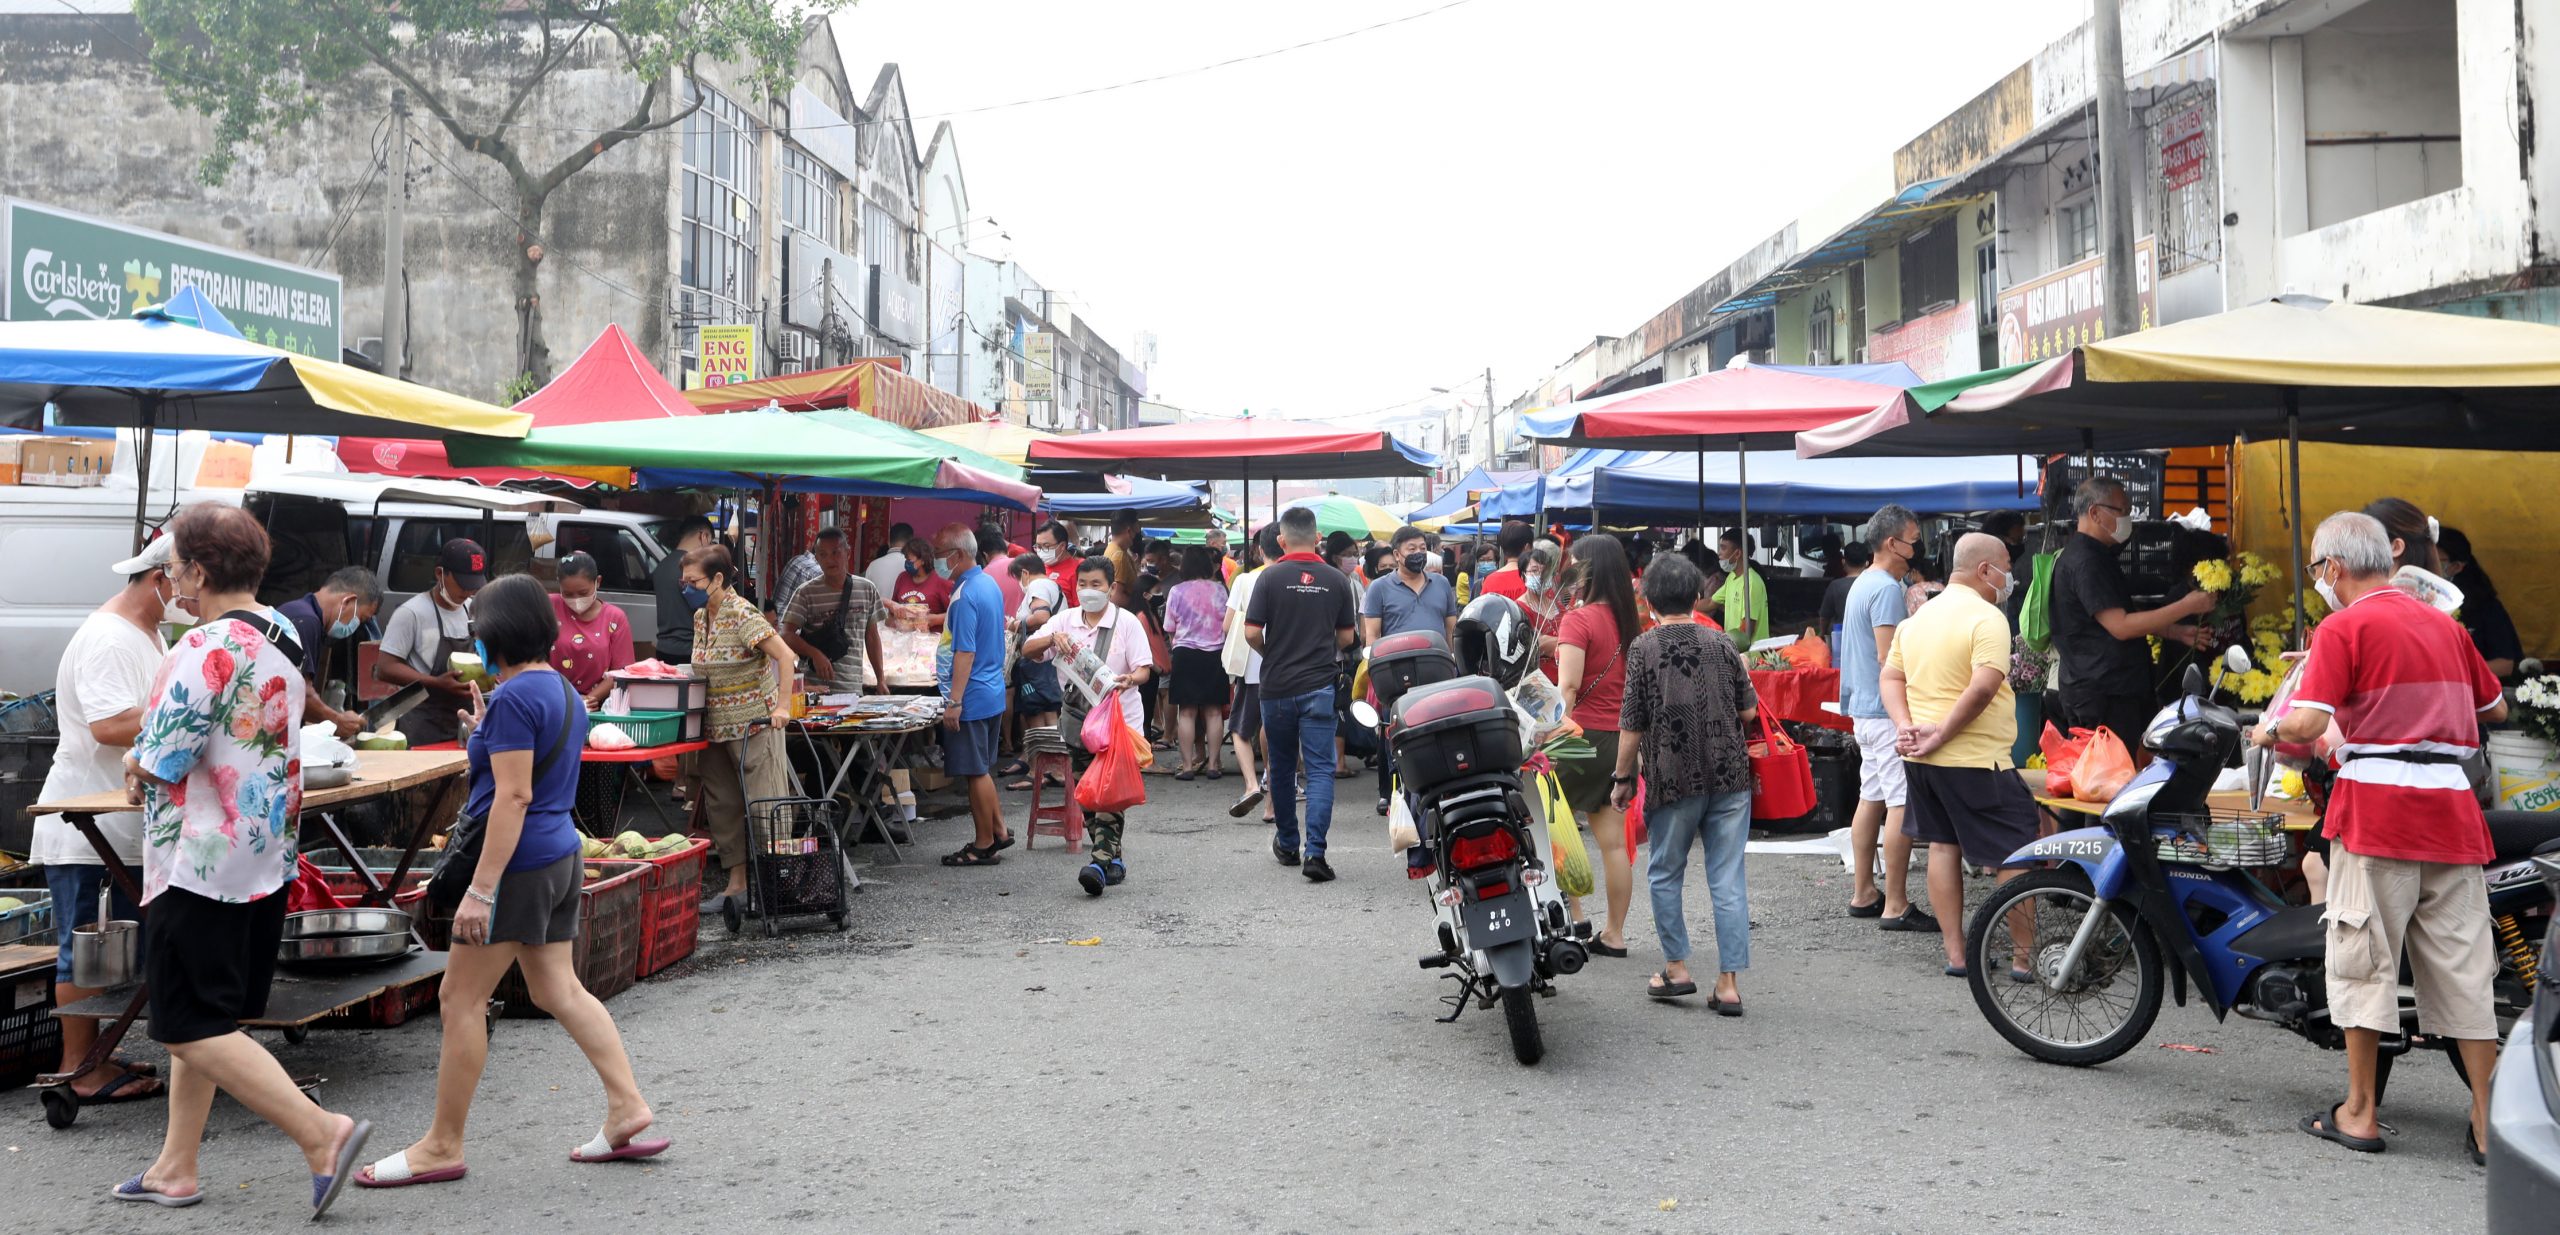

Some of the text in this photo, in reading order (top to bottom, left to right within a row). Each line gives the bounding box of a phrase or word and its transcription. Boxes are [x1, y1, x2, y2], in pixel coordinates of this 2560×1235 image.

[23, 248, 121, 316] Carlsberg
[244, 279, 288, 319] MEDAN
[290, 288, 332, 328] SELERA
[2027, 287, 2044, 328] NASI
[2044, 279, 2066, 322] AYAM
[2067, 269, 2091, 315] PUTIH
[704, 340, 745, 356] ENG
[704, 357, 747, 372] ANN
[2034, 840, 2102, 856] BJH 7215
[2169, 870, 2212, 881] HONDA
